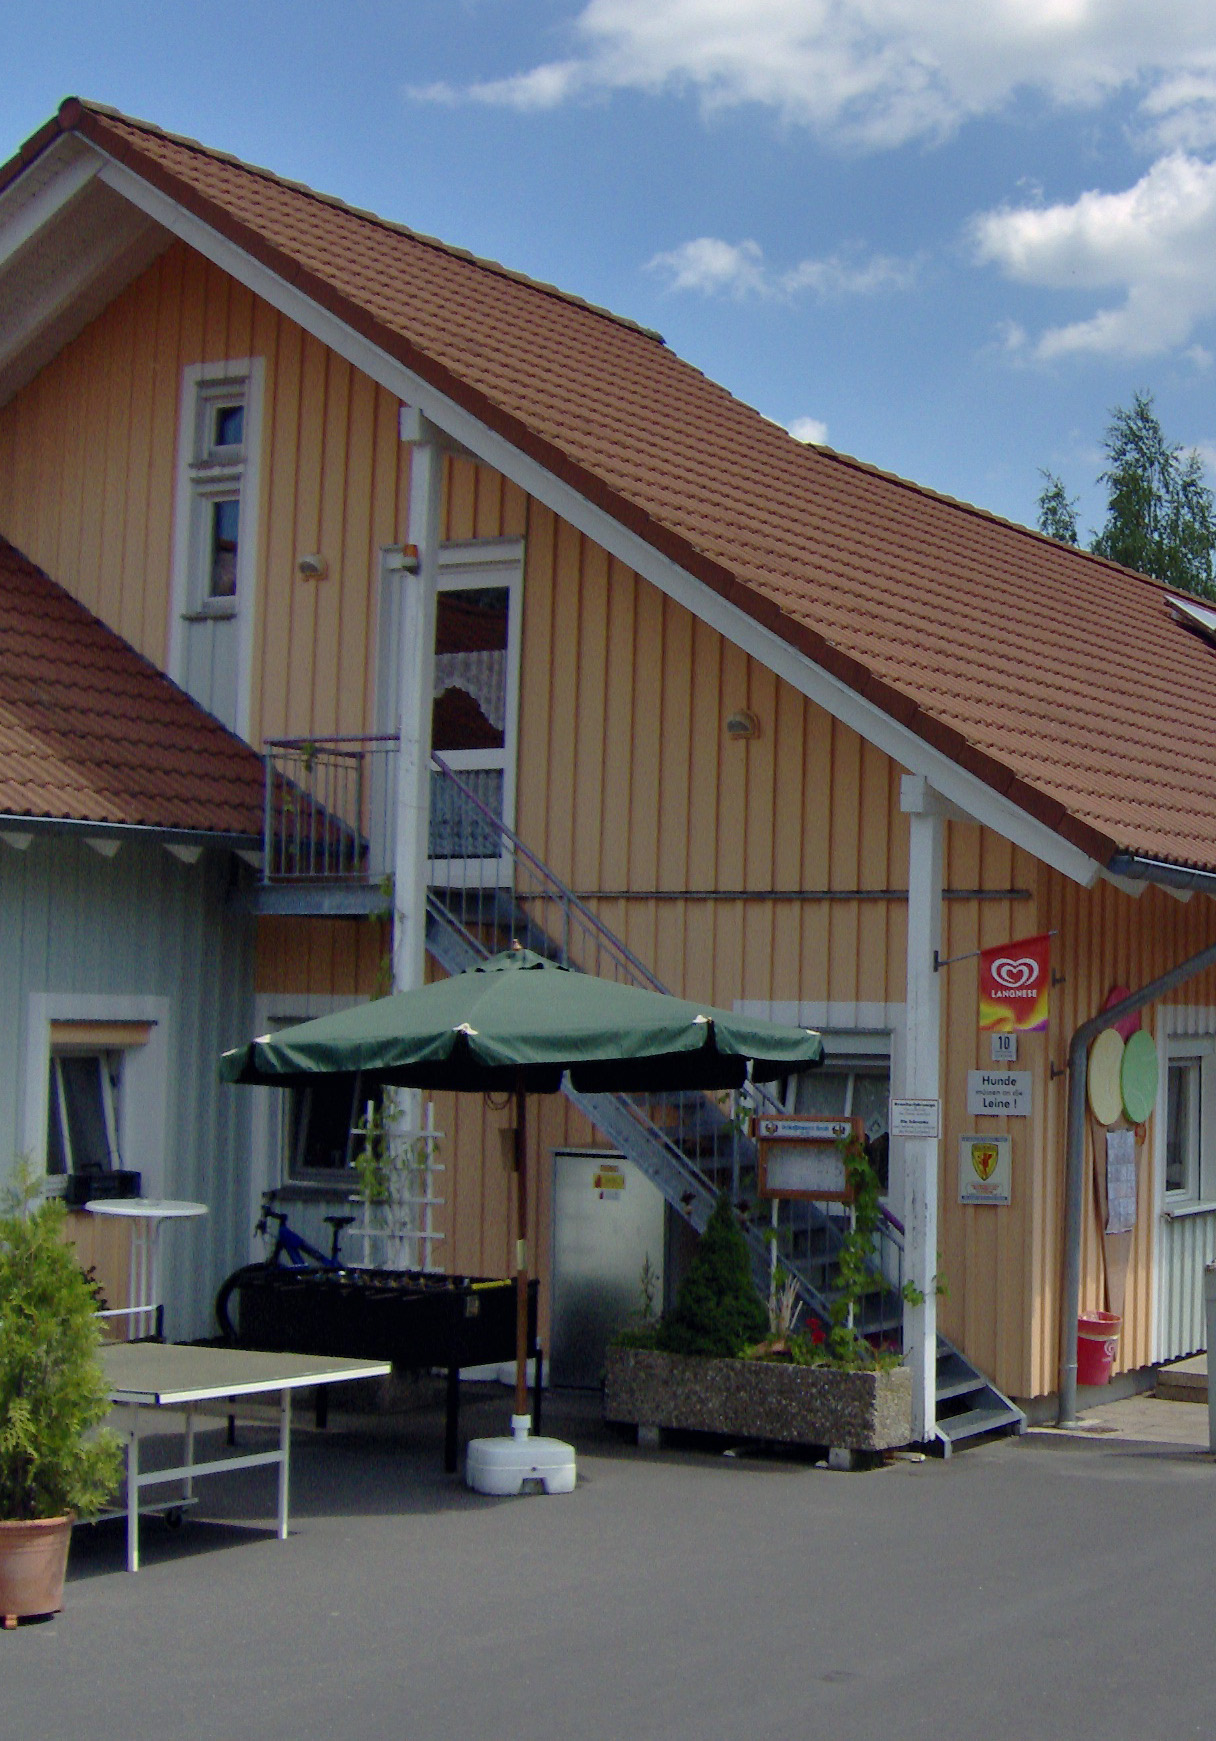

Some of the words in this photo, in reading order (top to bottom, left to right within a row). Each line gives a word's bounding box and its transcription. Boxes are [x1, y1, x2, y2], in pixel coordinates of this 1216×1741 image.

[991, 989, 1037, 998] LANGNESE
[998, 1035, 1010, 1050] 10
[982, 1075, 1017, 1086] Hunde
